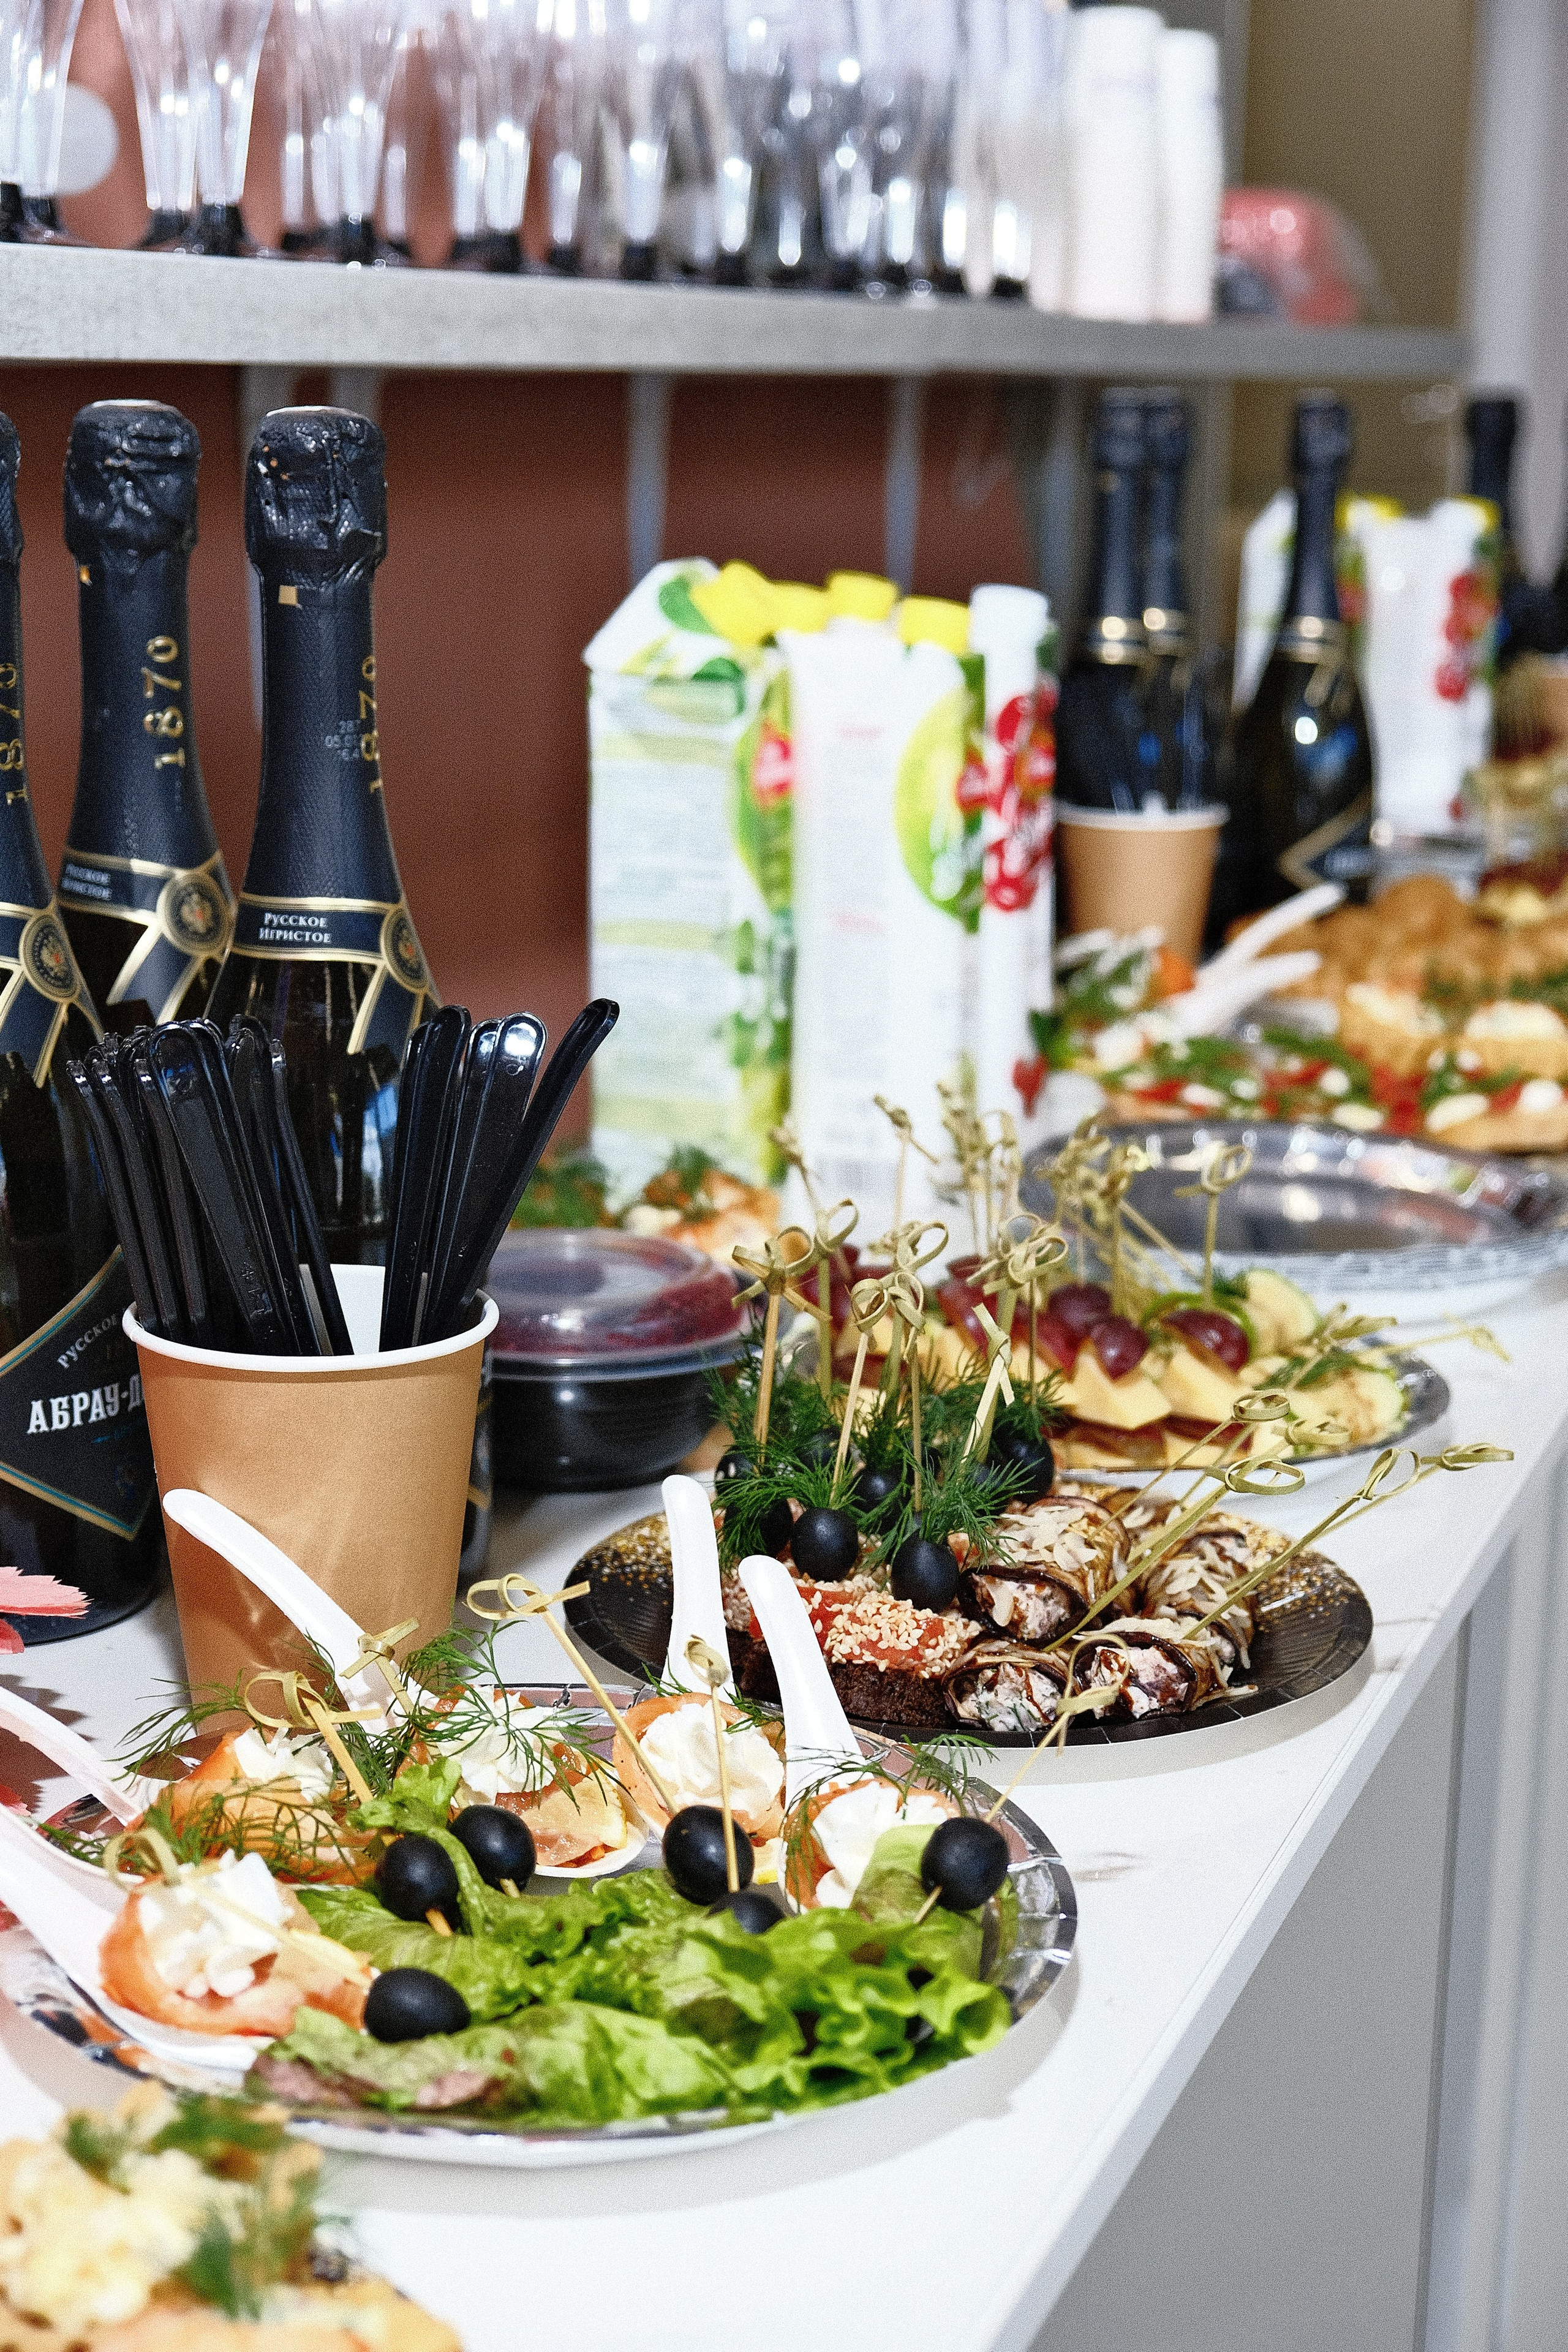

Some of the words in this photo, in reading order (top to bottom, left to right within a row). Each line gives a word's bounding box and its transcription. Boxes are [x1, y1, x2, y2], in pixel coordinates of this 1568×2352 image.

[141, 635, 184, 769] 1870
[264, 912, 328, 928] РУССКОЕ
[258, 927, 331, 943] ИГРИСТОЕ
